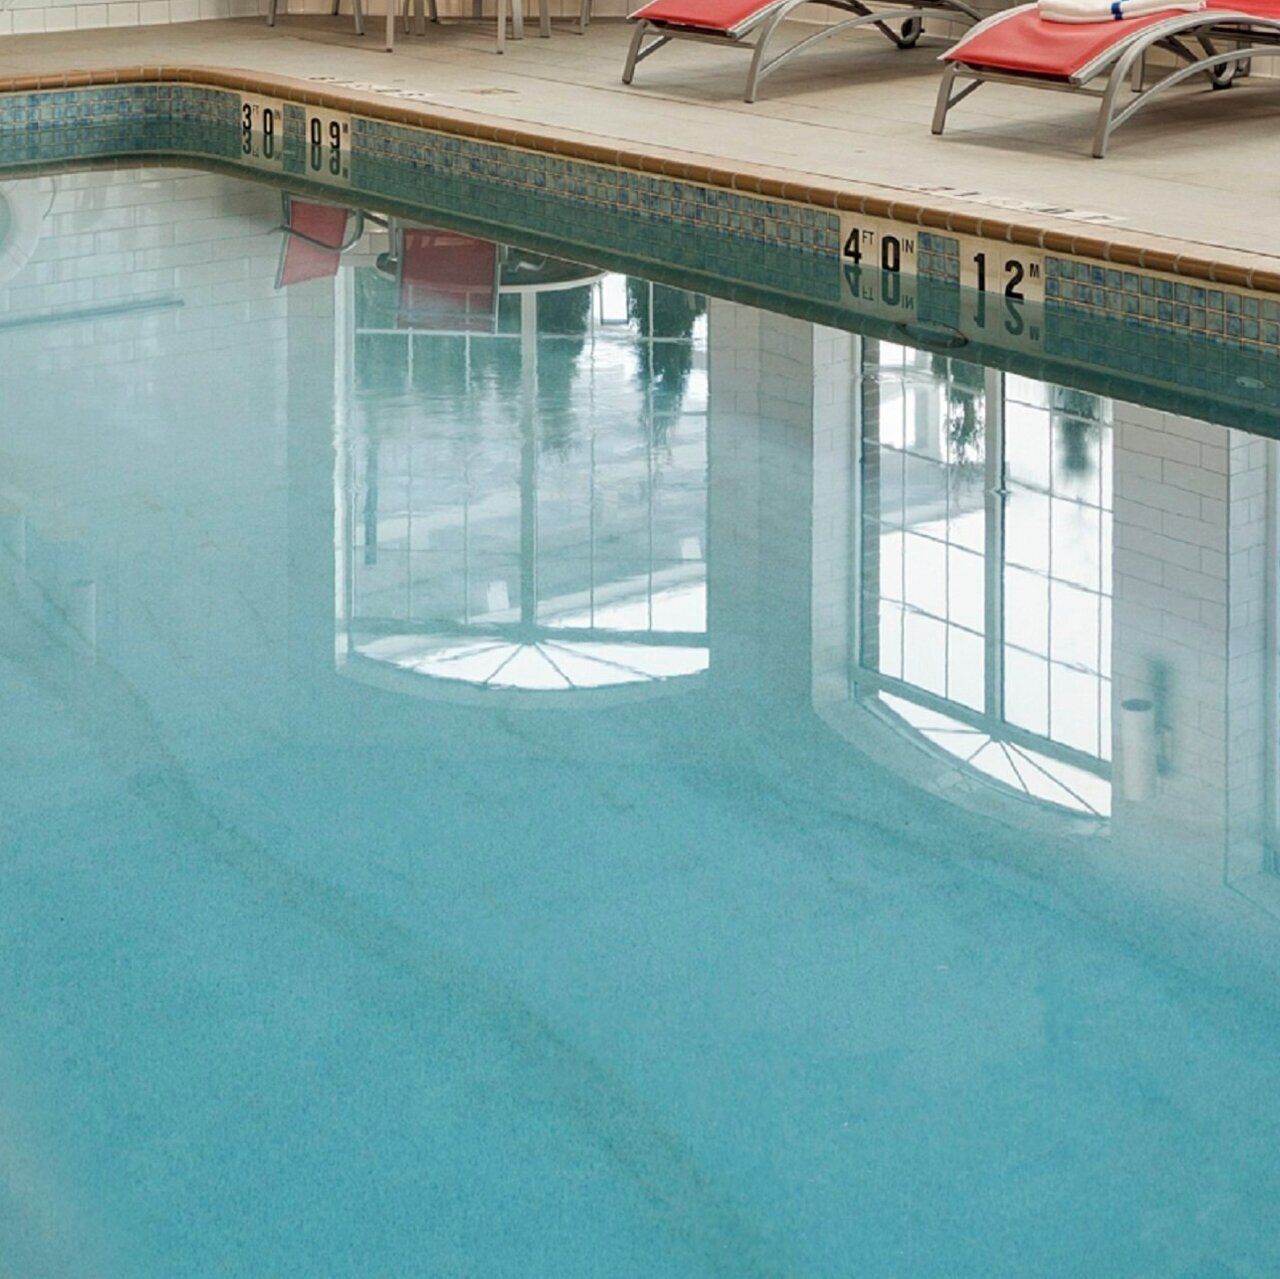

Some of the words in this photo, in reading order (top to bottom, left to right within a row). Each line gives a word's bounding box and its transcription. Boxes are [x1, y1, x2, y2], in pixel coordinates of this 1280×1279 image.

[844, 228, 862, 264] 4
[862, 230, 874, 245] FT
[881, 235, 900, 272] 0
[902, 239, 914, 253] IN
[1030, 263, 1040, 278] M
